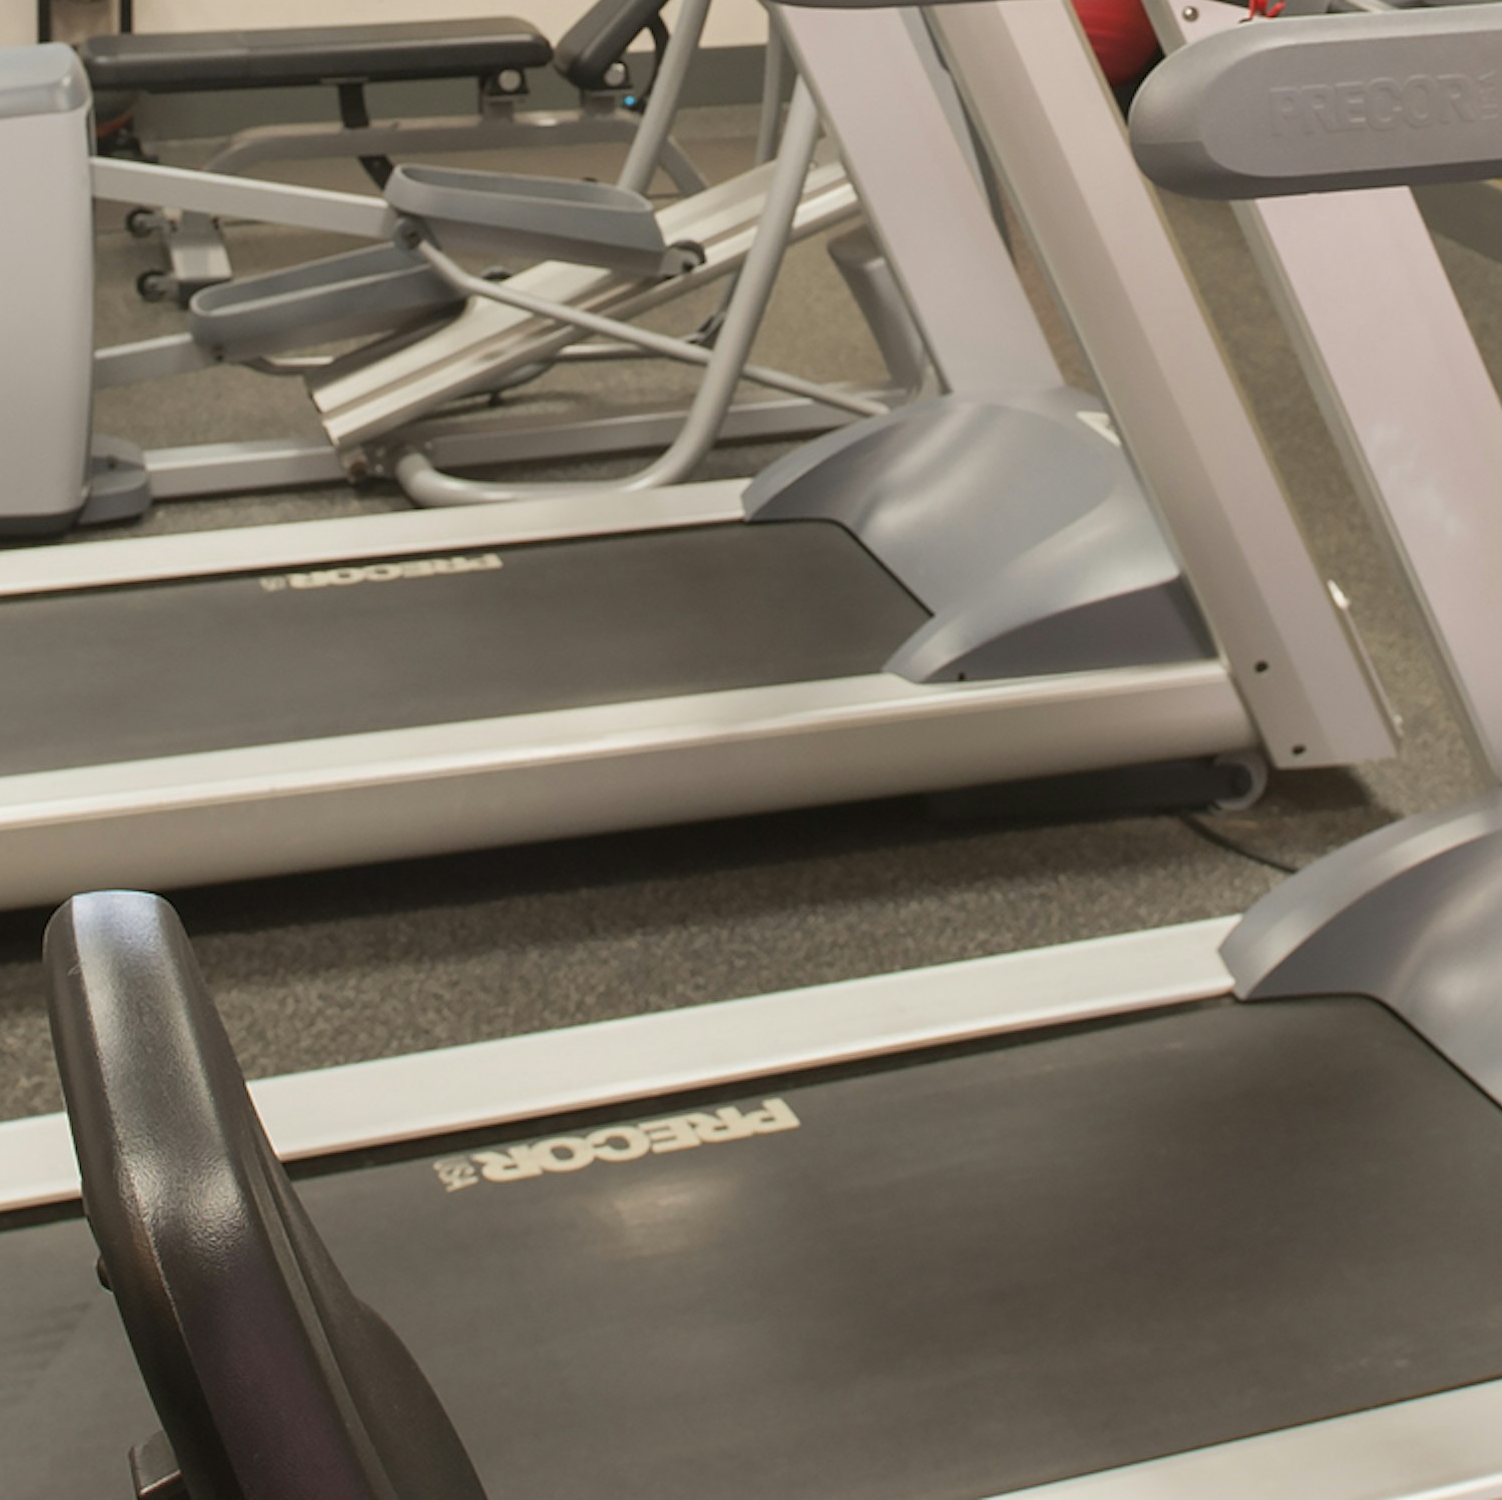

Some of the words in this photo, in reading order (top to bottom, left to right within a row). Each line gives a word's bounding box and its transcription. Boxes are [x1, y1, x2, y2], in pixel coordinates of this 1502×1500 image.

[1268, 73, 1477, 138] PRECOR
[287, 553, 503, 589] PRECOR
[472, 1098, 801, 1183] PRECOR
